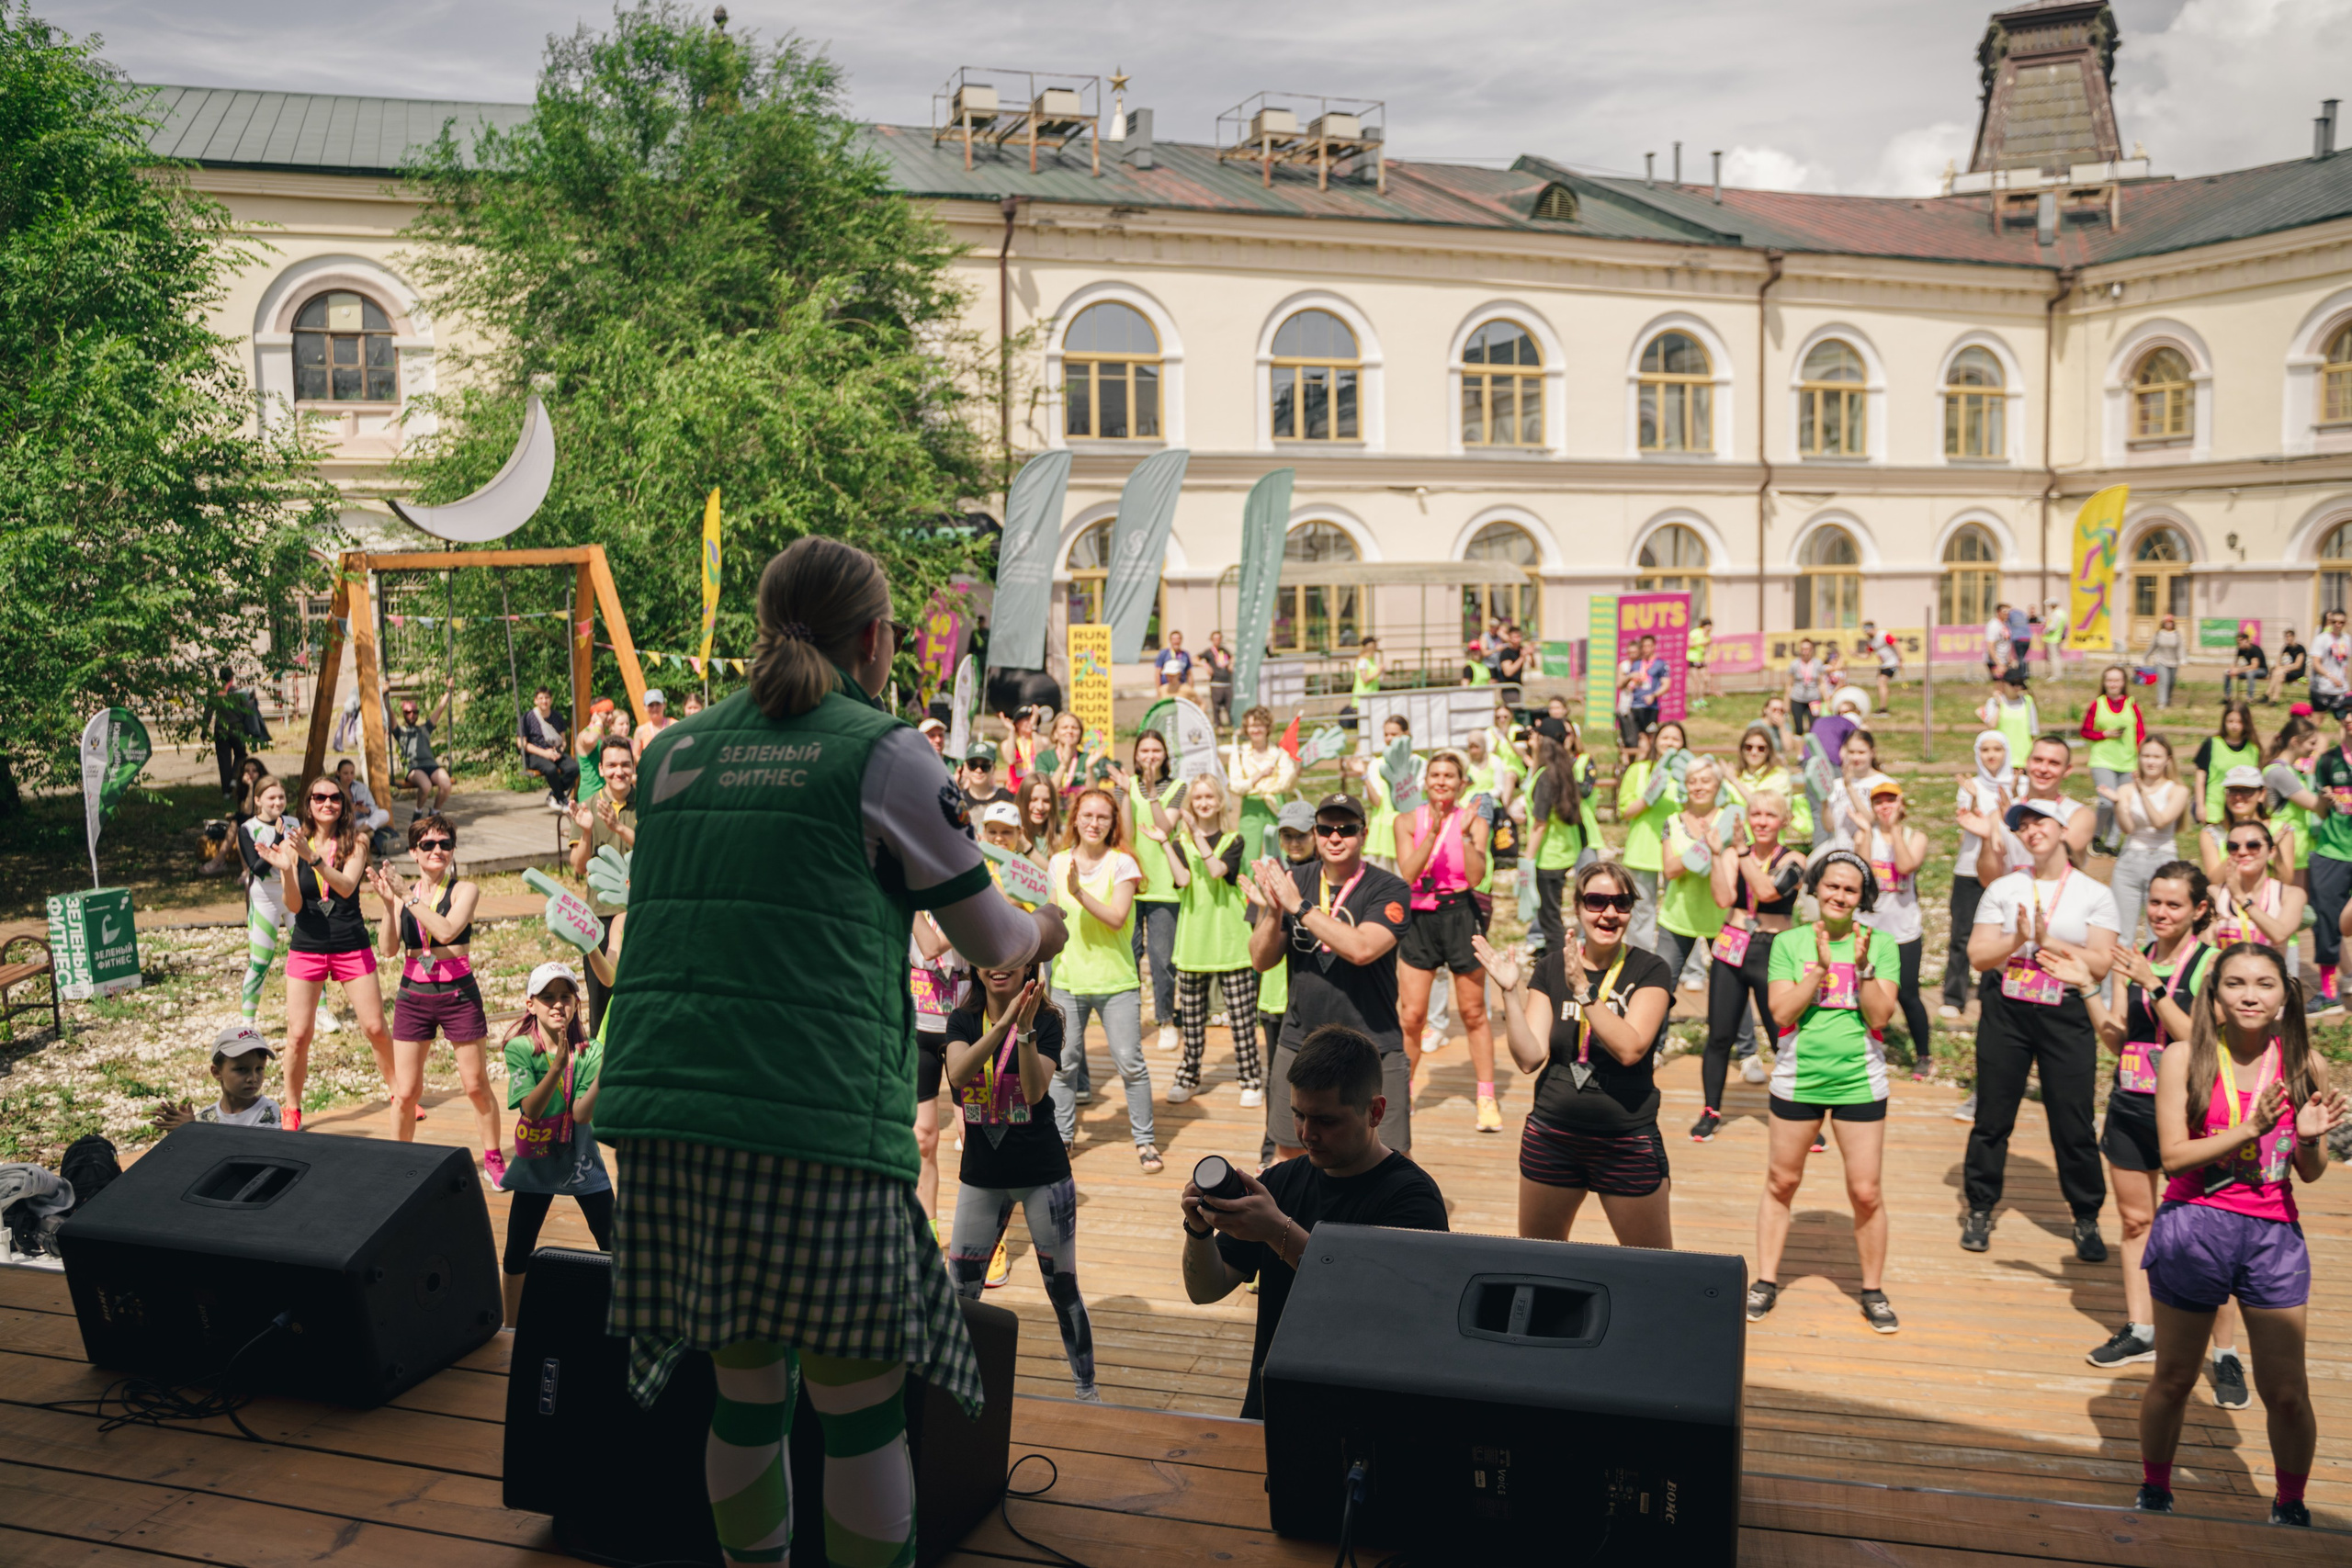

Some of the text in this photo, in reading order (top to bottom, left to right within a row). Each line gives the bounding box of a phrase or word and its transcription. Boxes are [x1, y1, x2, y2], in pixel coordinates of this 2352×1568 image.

[1621, 600, 1687, 631] RUTS
[1073, 630, 1107, 640] RUN
[1075, 680, 1107, 689] RUN
[1075, 691, 1108, 701] RUN
[1075, 704, 1108, 713] RUN
[718, 741, 822, 763] ЗЕЛЕНЫЙ
[718, 769, 808, 787] ФИТНЕС
[1012, 859, 1048, 883] БЕГИ
[1010, 869, 1047, 897] ТУДА
[560, 894, 600, 929] БЕГИ
[556, 902, 597, 942] ТУДА
[47, 897, 73, 985] ФИТНЕС
[65, 897, 93, 986] ЗЕЛЕНЫЙ
[95, 942, 133, 961] ЗЕЛЕНЫЙ
[97, 954, 132, 970] ФИТНЕС
[910, 979, 933, 997] 257
[2120, 1054, 2141, 1072] 111
[516, 1123, 552, 1143] 052
